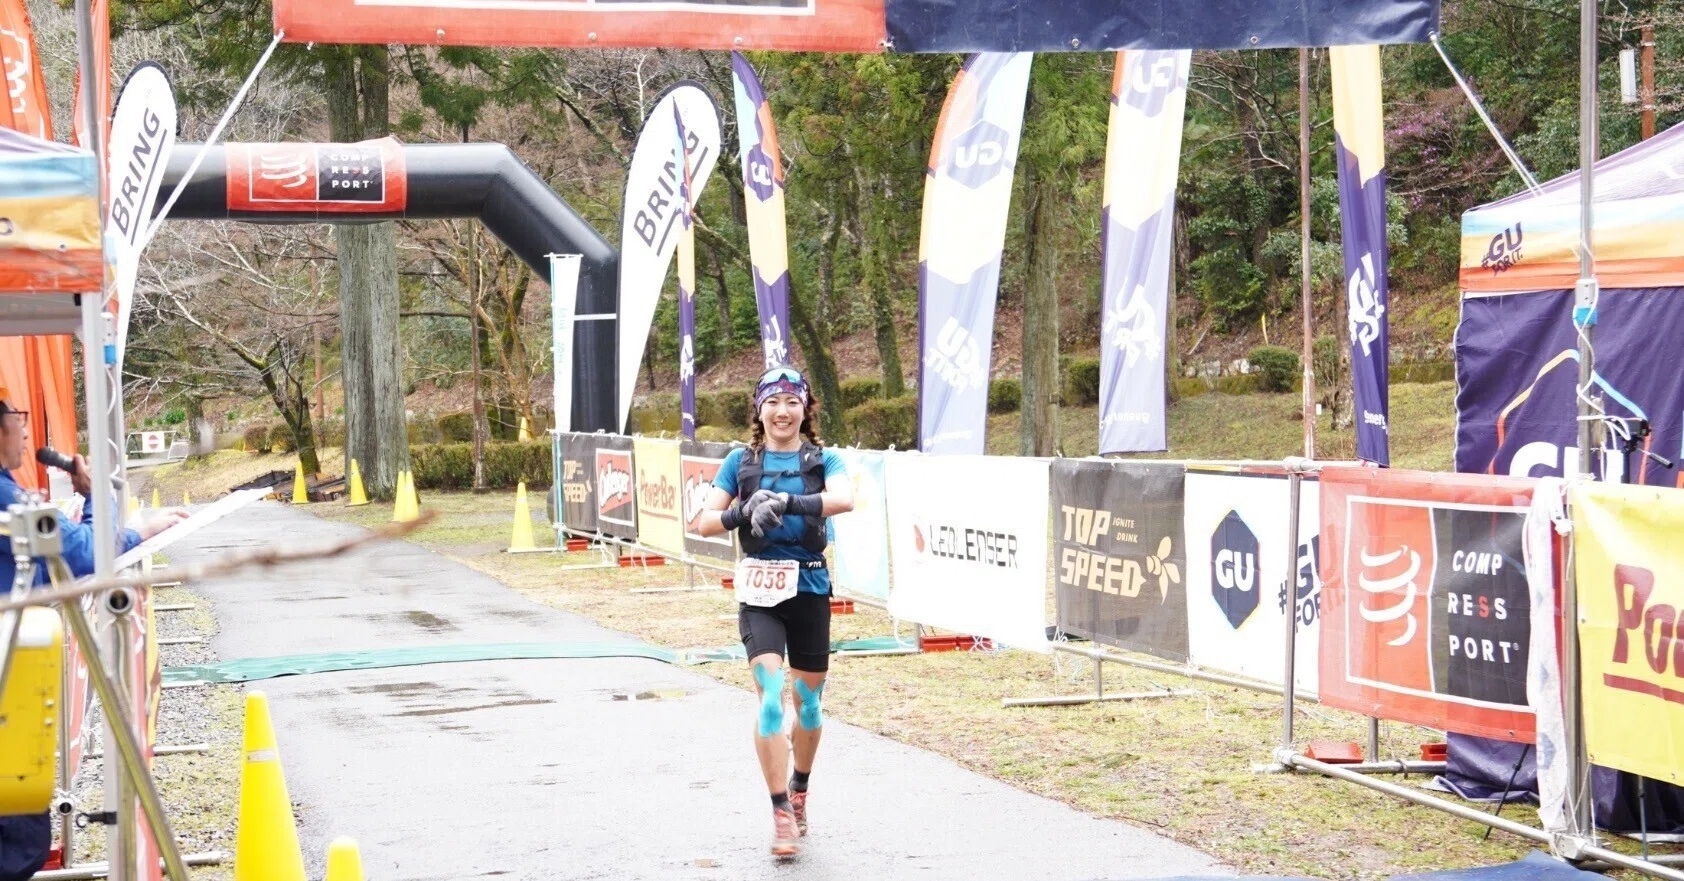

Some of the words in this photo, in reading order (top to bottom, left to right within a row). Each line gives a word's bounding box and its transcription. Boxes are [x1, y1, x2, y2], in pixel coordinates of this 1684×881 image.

[111, 107, 160, 237] BRING
[331, 166, 369, 174] RESS
[1061, 504, 1111, 546] TOP
[1113, 517, 1135, 528] IGNITE
[1116, 532, 1138, 544] DRINK
[1060, 547, 1147, 598] SPEED
[1215, 548, 1255, 592] GU
[1452, 550, 1502, 575] COMP
[745, 568, 786, 590] 1058
[1447, 592, 1507, 620] RESS
[1612, 563, 1684, 679] Po
